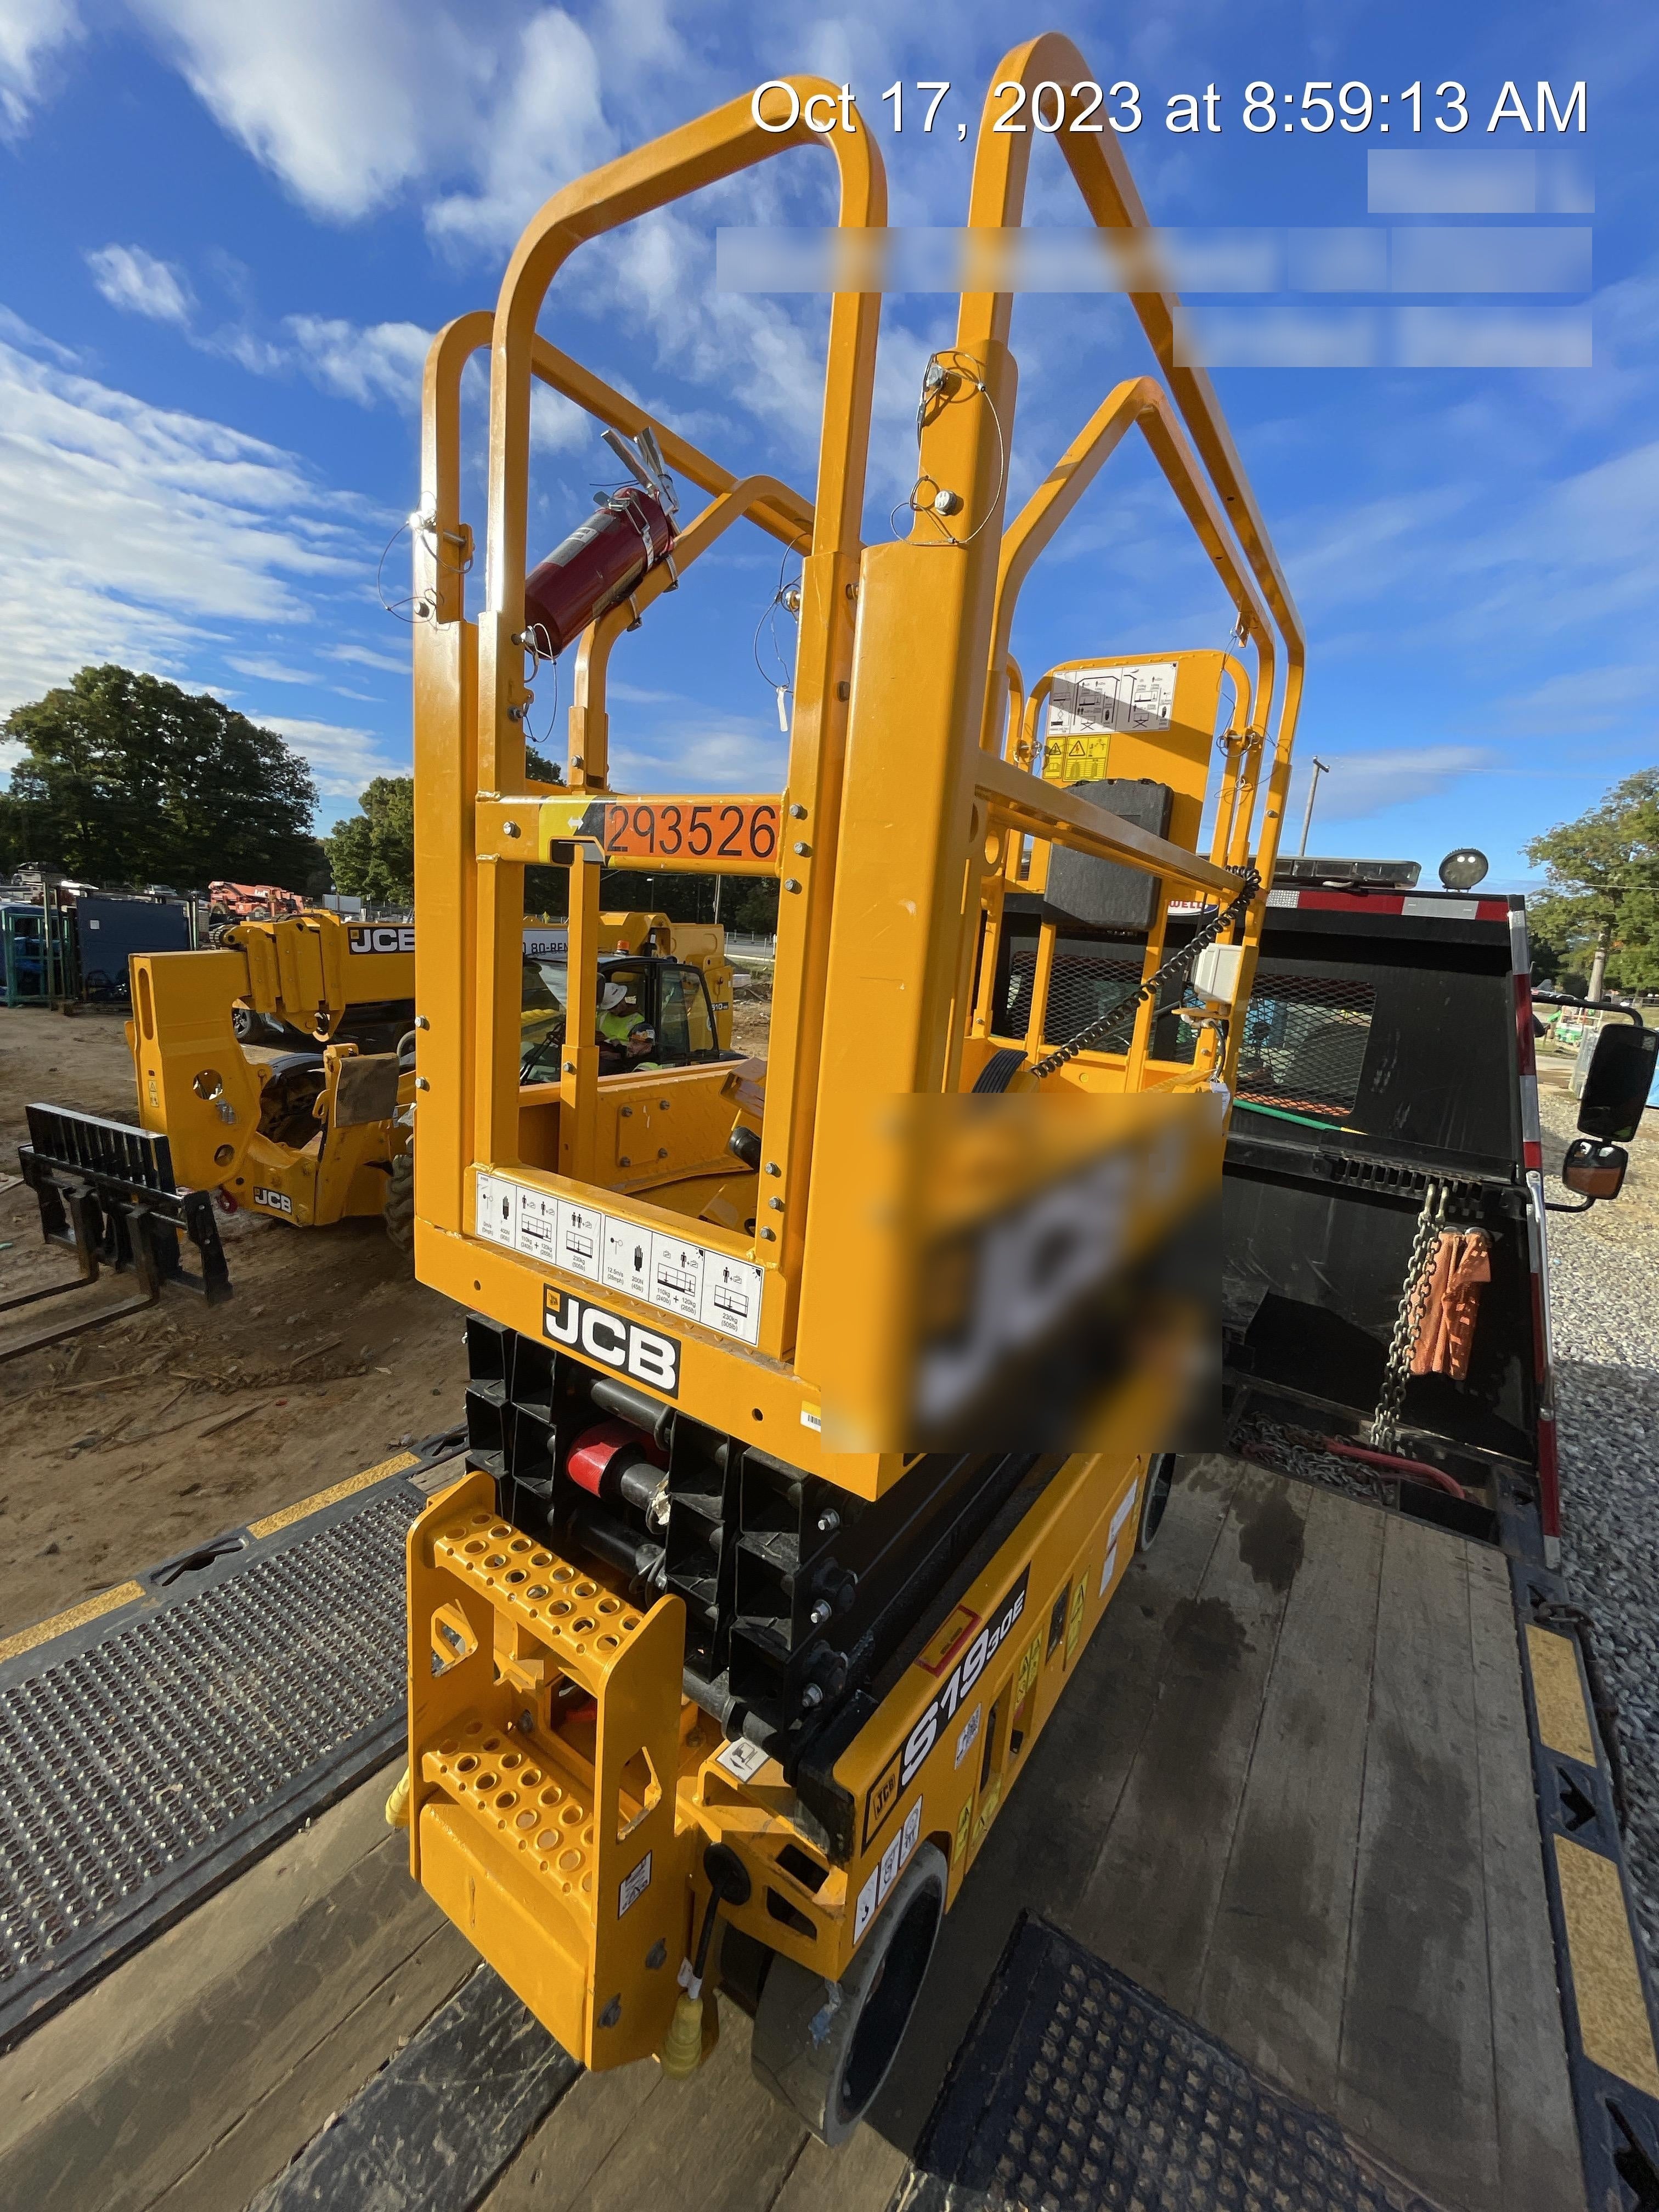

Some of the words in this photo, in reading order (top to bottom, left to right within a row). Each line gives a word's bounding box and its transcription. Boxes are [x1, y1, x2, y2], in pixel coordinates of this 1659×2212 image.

[607, 805, 776, 857] 293526
[255, 1190, 292, 1213] JCB
[723, 1312, 738, 1324] 230kg
[545, 1297, 676, 1390] JCB
